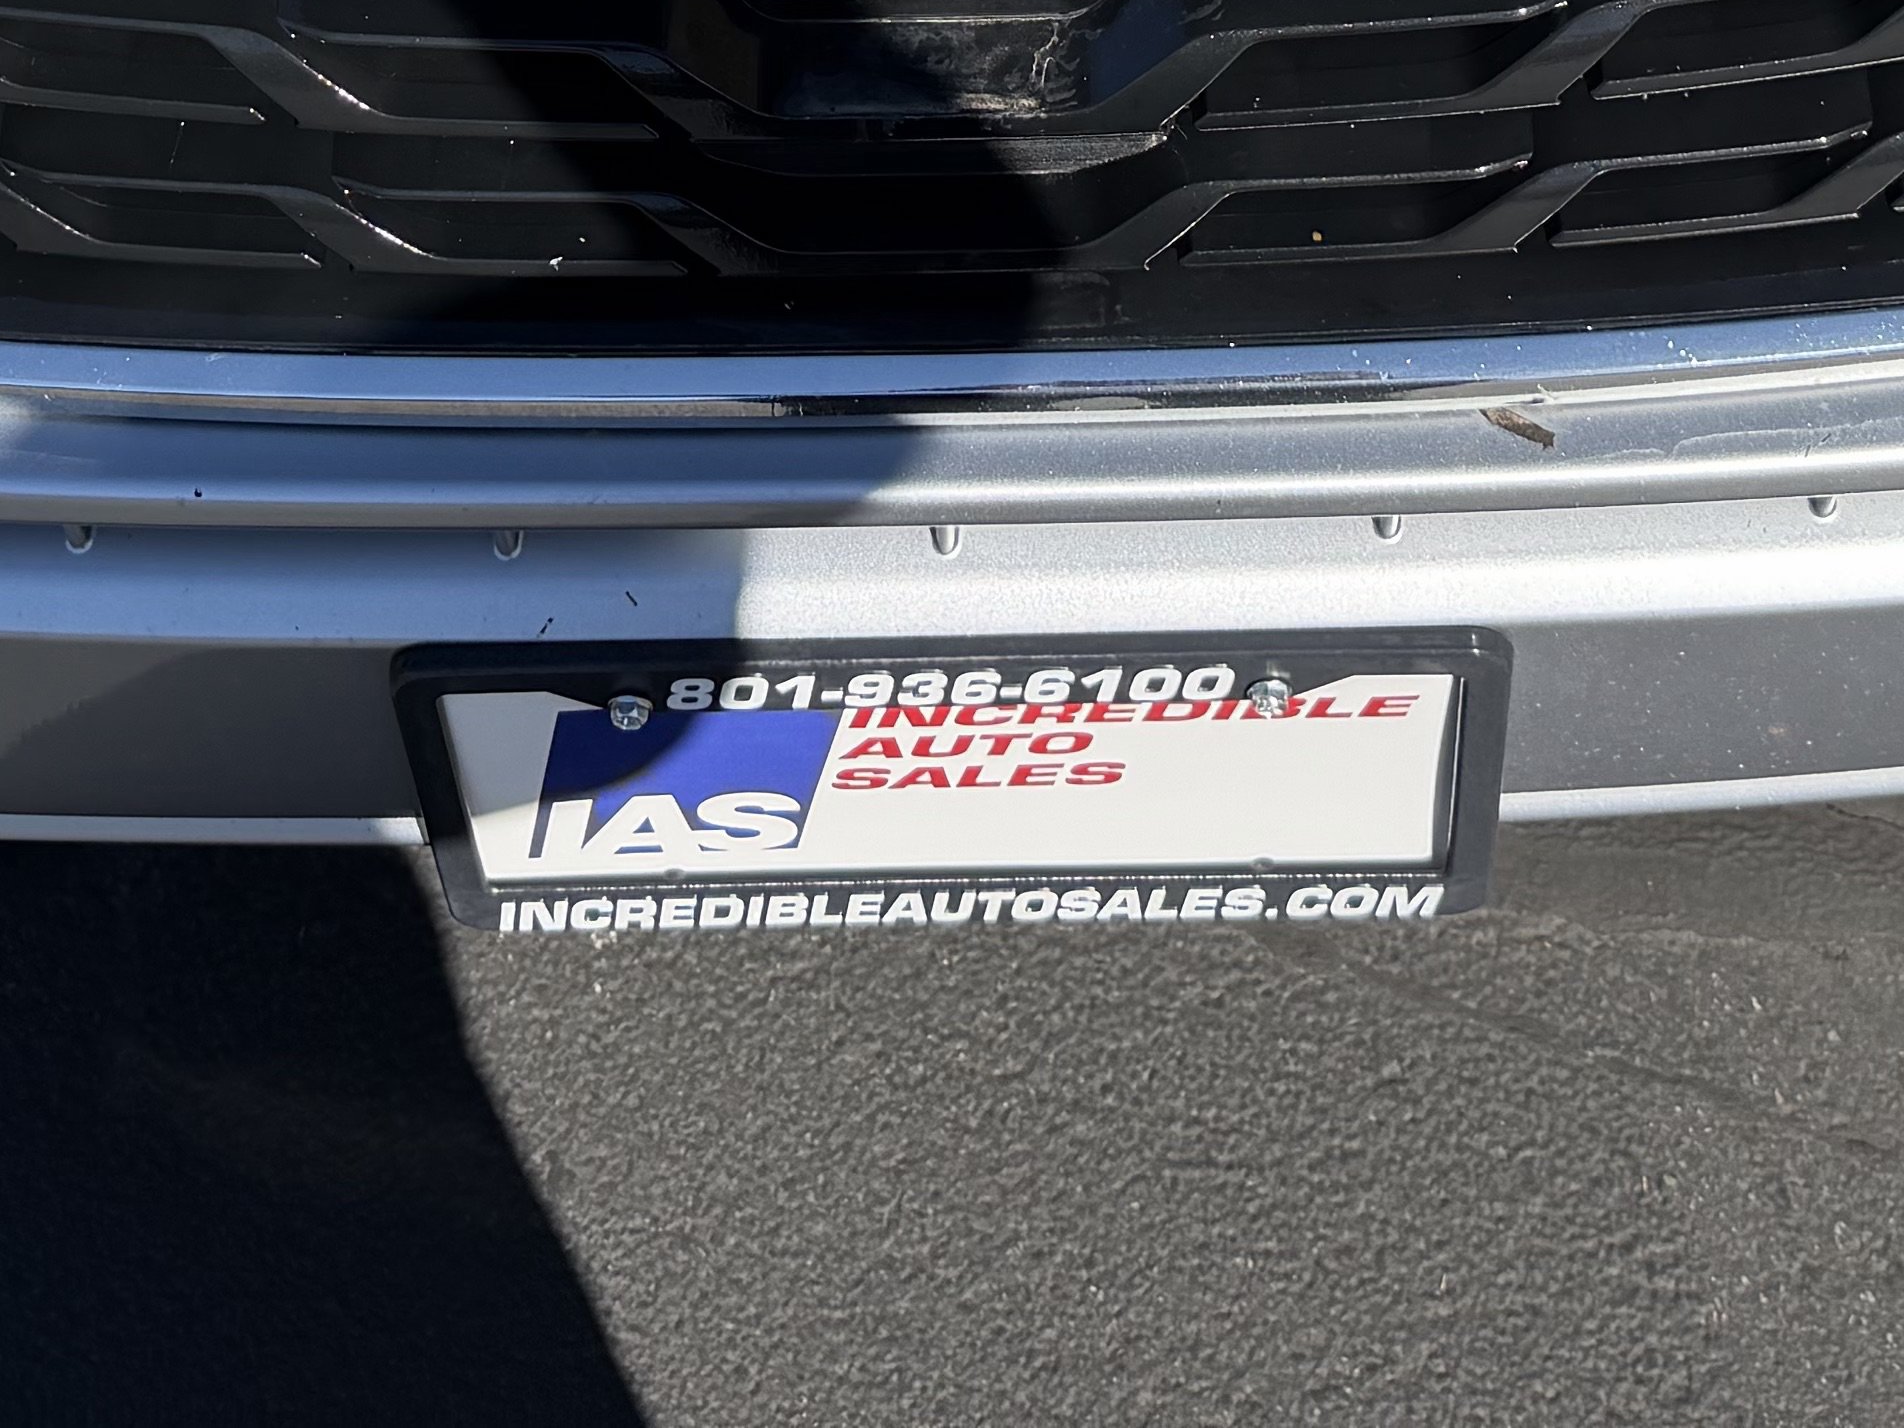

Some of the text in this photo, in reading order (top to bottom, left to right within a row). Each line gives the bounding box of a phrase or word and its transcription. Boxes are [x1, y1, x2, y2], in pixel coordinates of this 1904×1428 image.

[666, 668, 1237, 711] 801-936-6100
[839, 732, 1094, 759] AUTO
[831, 762, 1127, 790] SALES
[539, 791, 802, 858] IAS
[498, 883, 1444, 934] INCREDIBLEAUTOSALES.COM
